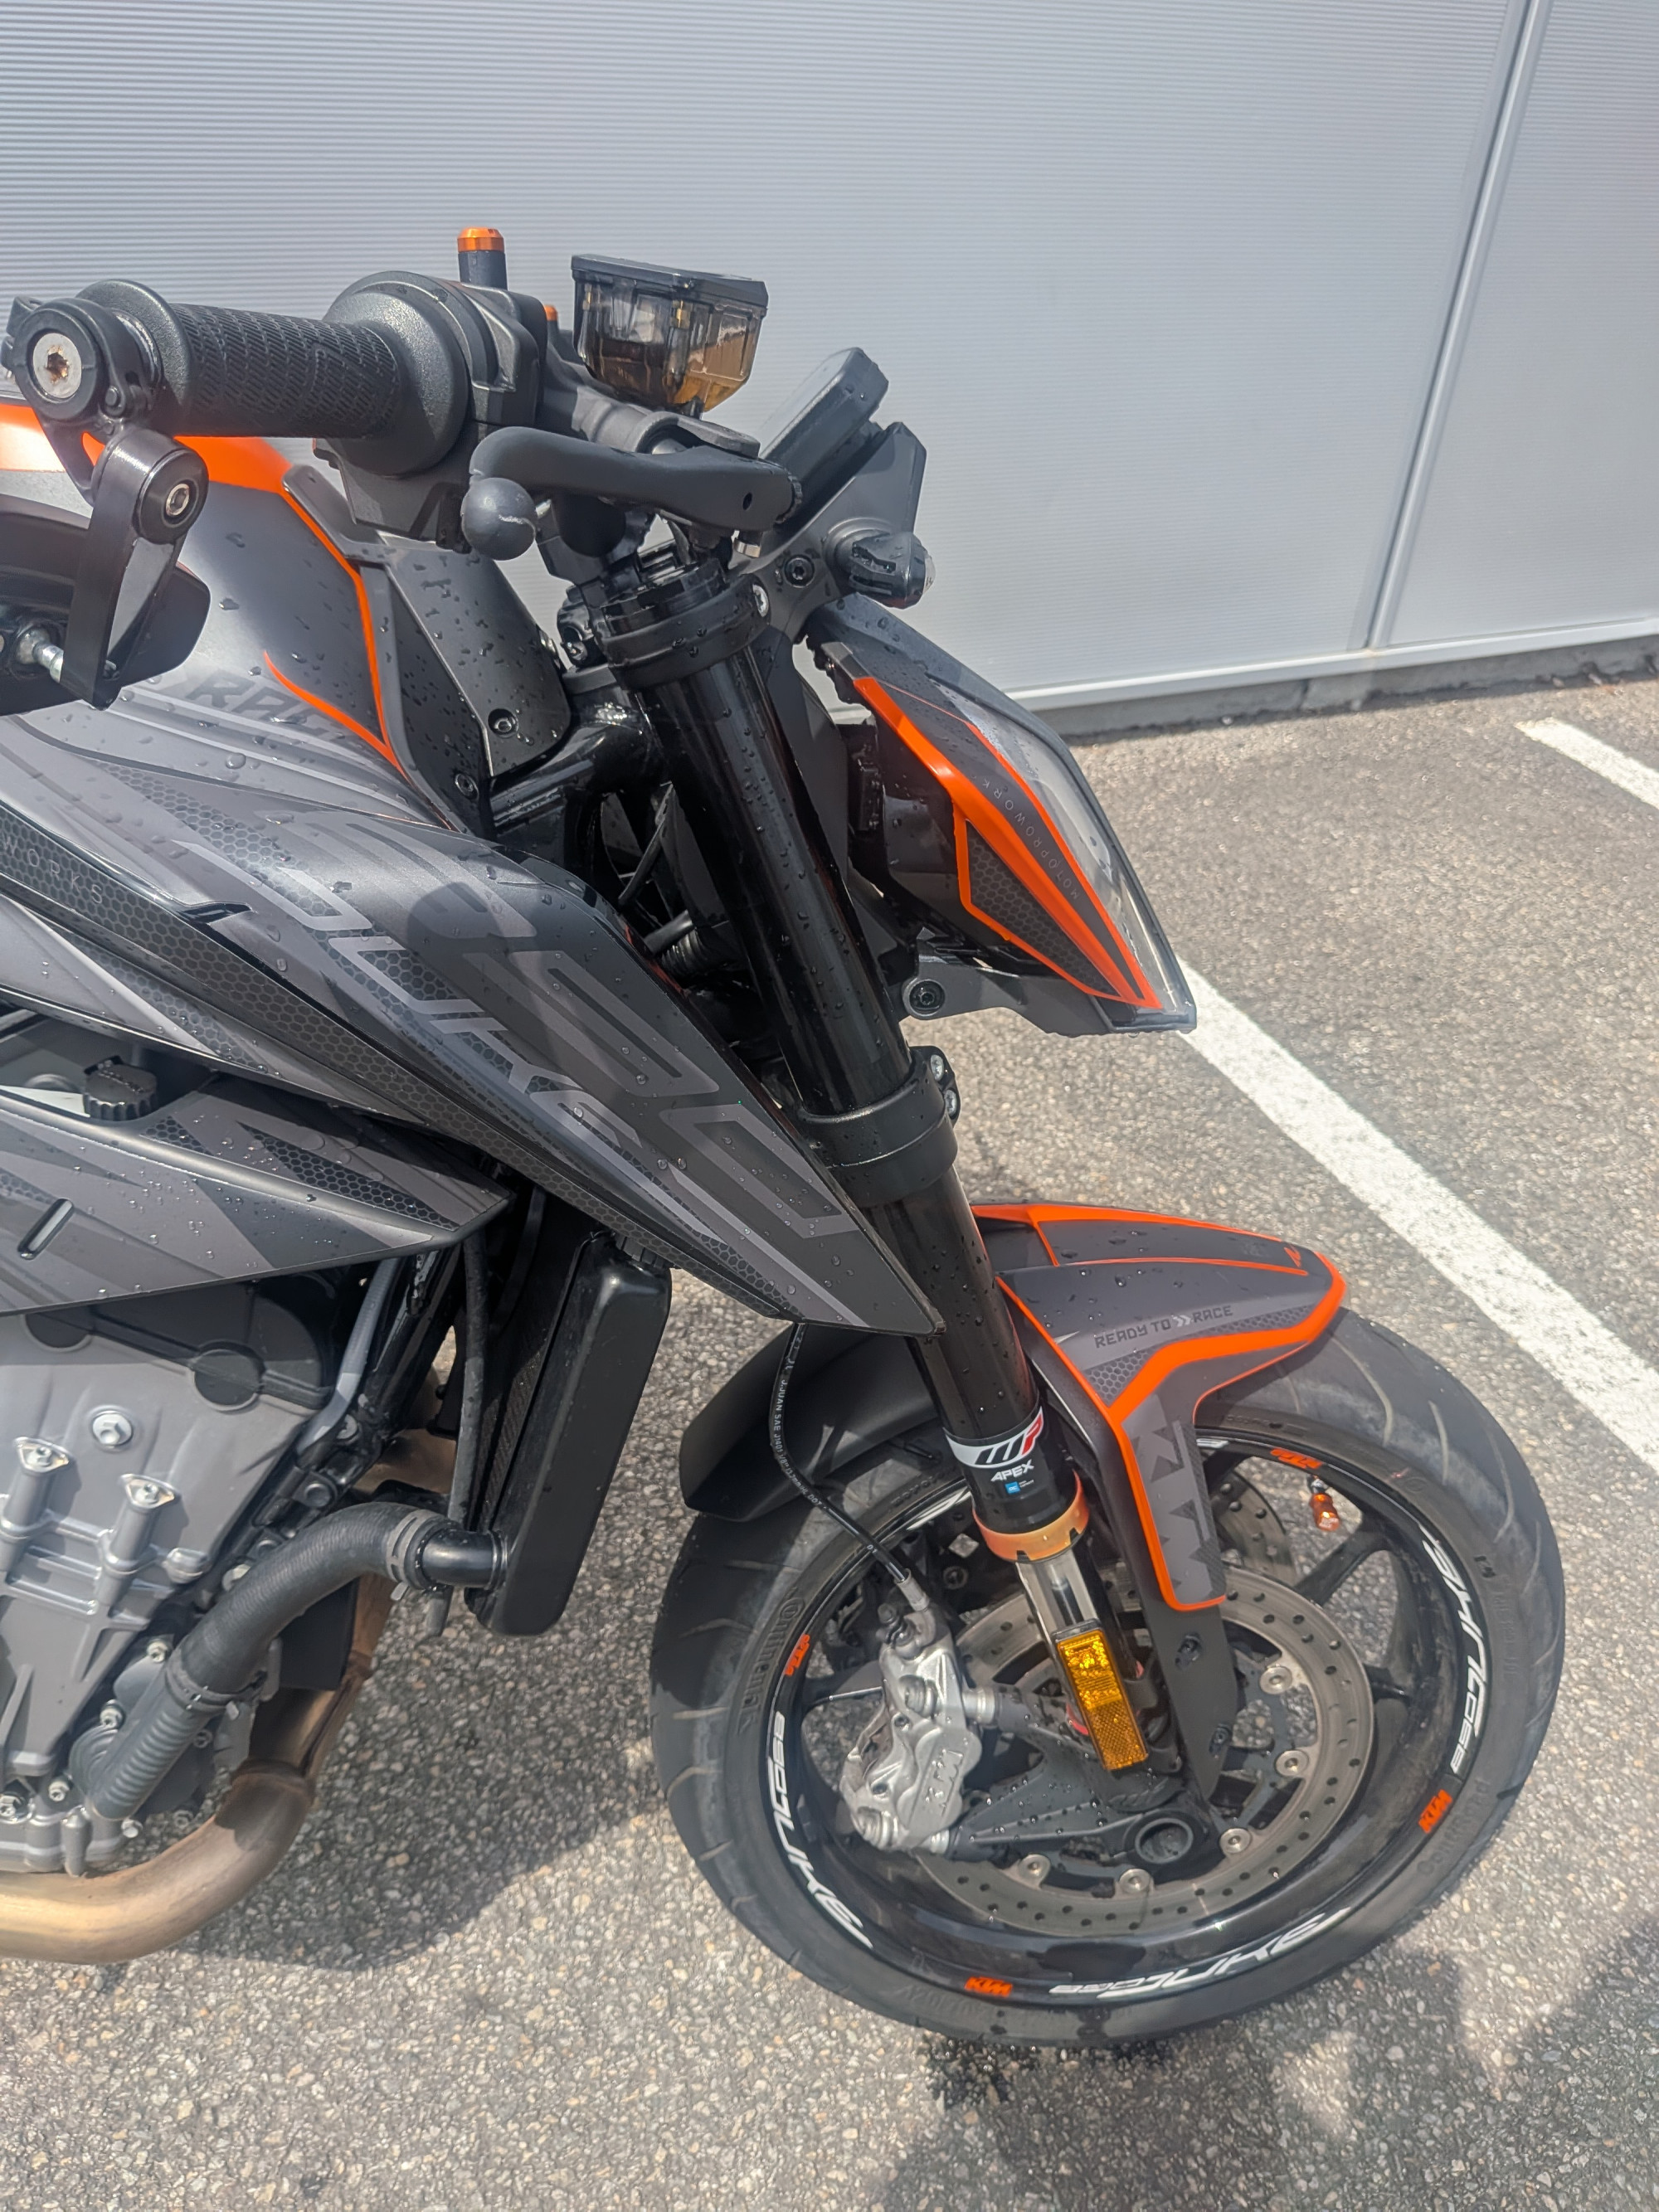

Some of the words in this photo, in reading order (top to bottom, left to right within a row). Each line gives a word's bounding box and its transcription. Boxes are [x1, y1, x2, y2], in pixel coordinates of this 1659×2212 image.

[971, 775, 1079, 901] MOTOPROWORK
[171, 841, 724, 1241] DUKE
[262, 809, 859, 1239] 890
[1093, 1325, 1149, 1349] READY
[1151, 1319, 1172, 1333] TO
[1192, 1305, 1233, 1323] RACE
[773, 1413, 783, 1432] SAE
[990, 1458, 1035, 1482] APEX
[1123, 1394, 1214, 1607] KTM
[1419, 1524, 1487, 1738] DUKE
[767, 1755, 873, 1949] DUKE
[1418, 1789, 1453, 1834] KTM
[964, 1976, 1014, 1998] KTM
[1096, 1906, 1351, 1999] DUKE
